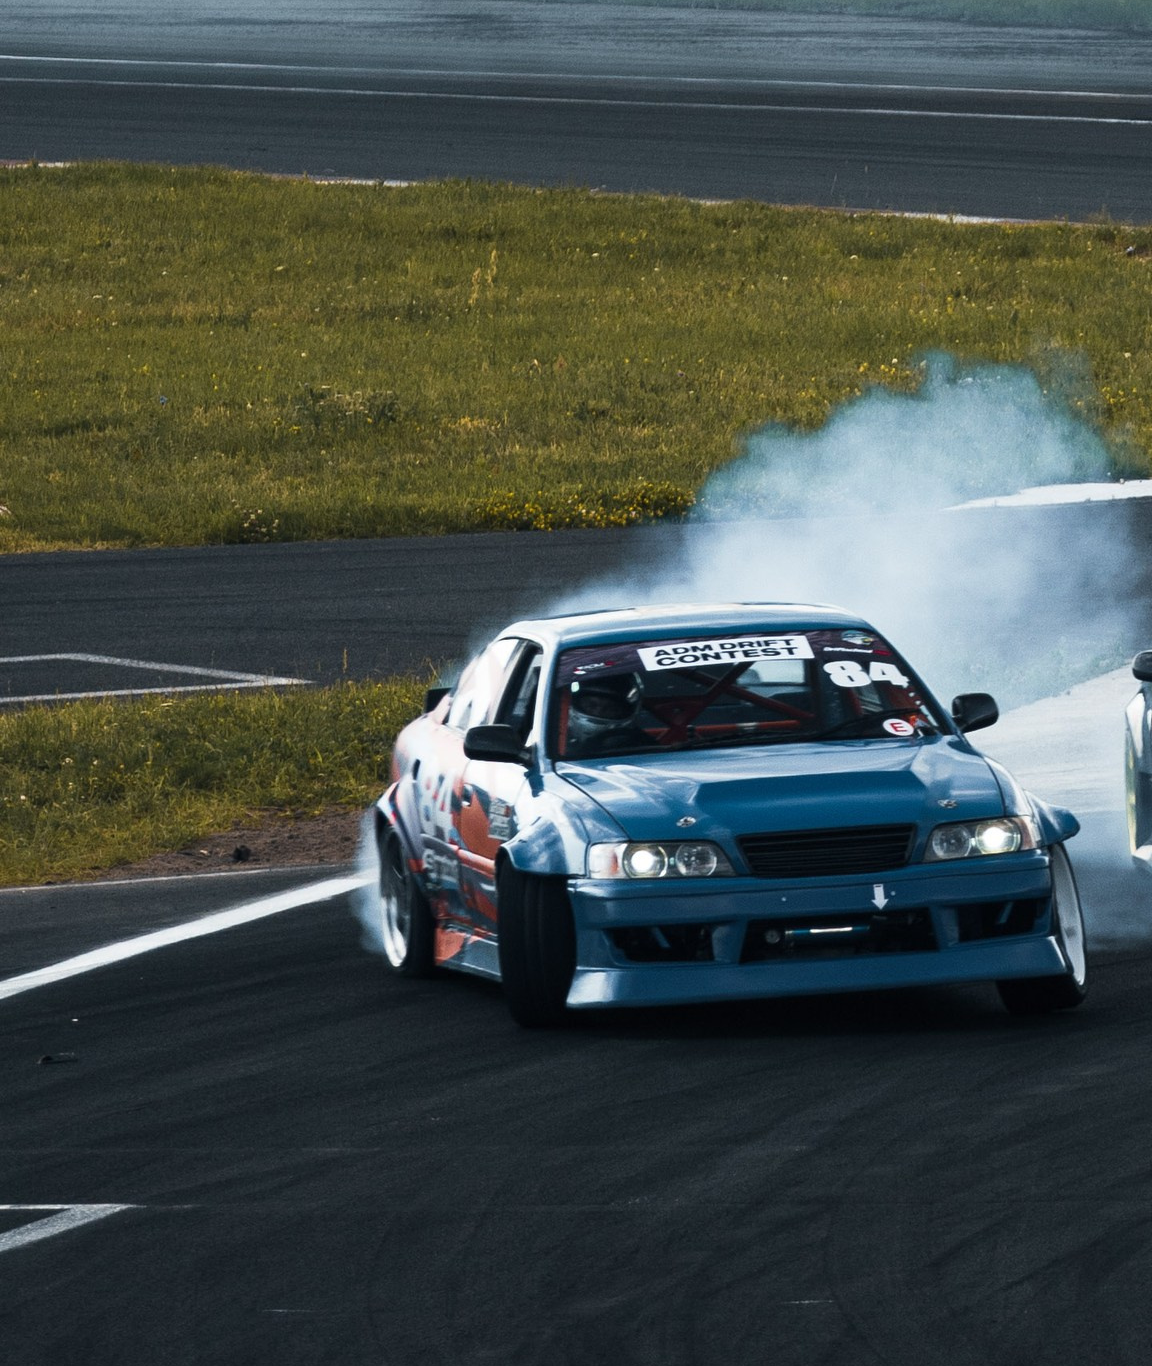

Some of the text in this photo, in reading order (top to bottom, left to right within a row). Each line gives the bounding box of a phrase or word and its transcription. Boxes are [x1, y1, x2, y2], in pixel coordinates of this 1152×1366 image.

[654, 638, 795, 658] ADM DRIFT
[656, 646, 798, 667] CONTEST
[823, 660, 910, 688] 84
[889, 722, 908, 733] E
